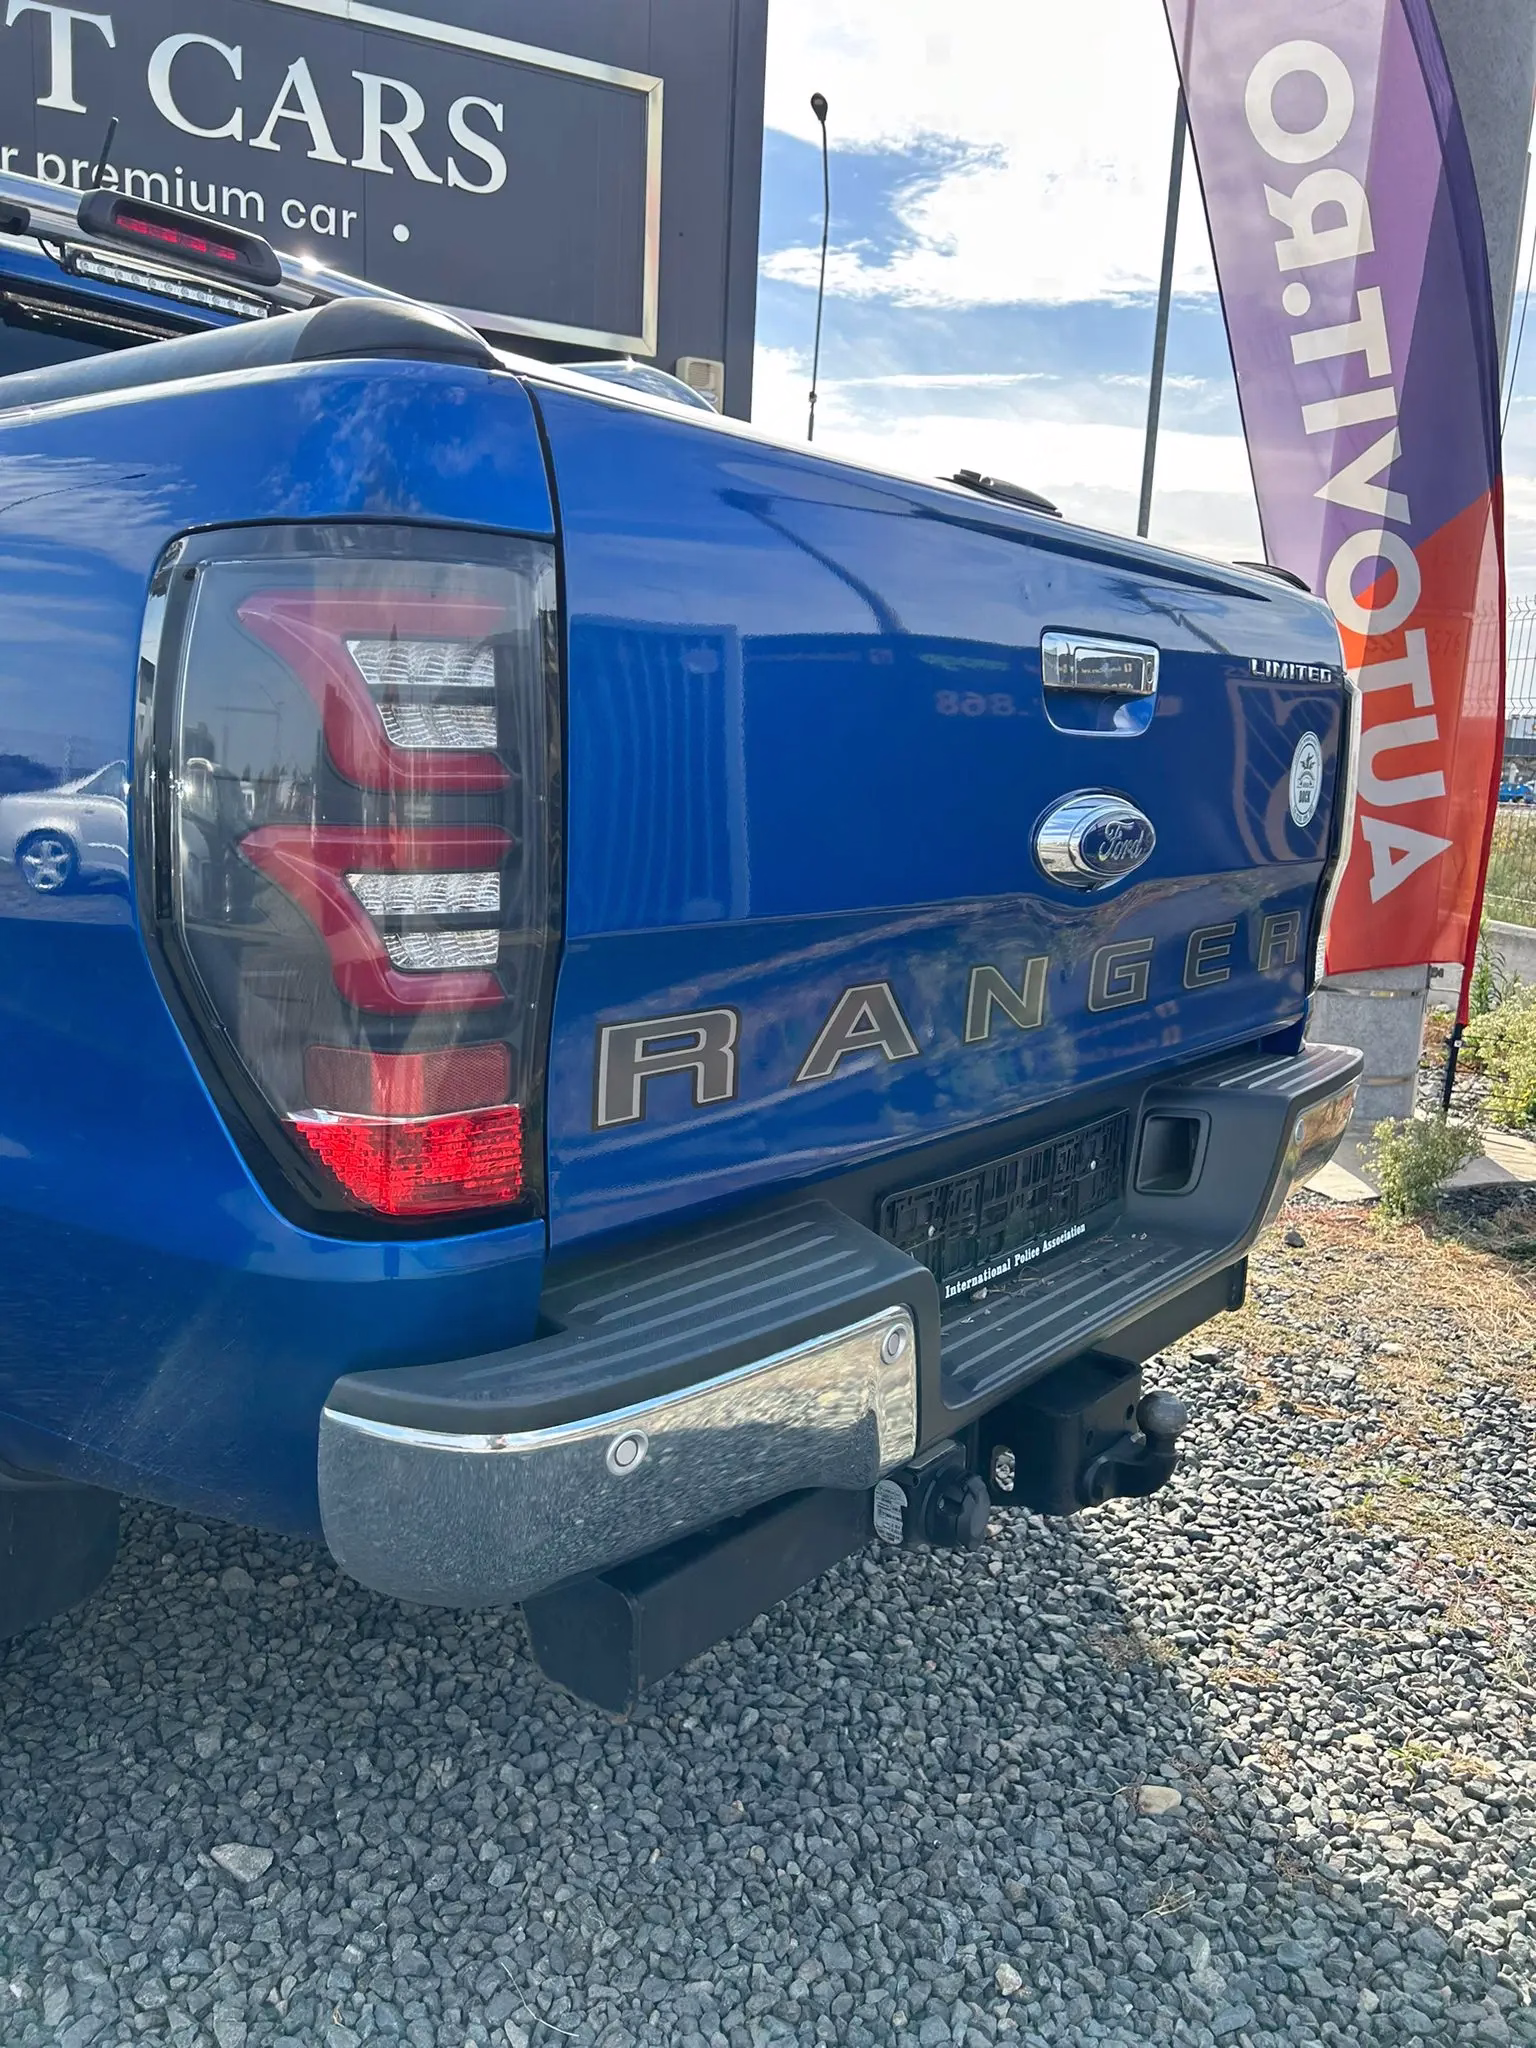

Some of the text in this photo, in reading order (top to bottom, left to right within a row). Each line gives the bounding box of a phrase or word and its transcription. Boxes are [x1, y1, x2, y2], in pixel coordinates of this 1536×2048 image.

[147, 33, 508, 195] CARS
[36, 152, 265, 222] premium
[280, 197, 358, 240] car
[1251, 658, 1332, 684] LIMITED
[1098, 820, 1145, 862] Ford
[594, 909, 1301, 1128] RANGER
[944, 1222, 1087, 1299] International Police Association
